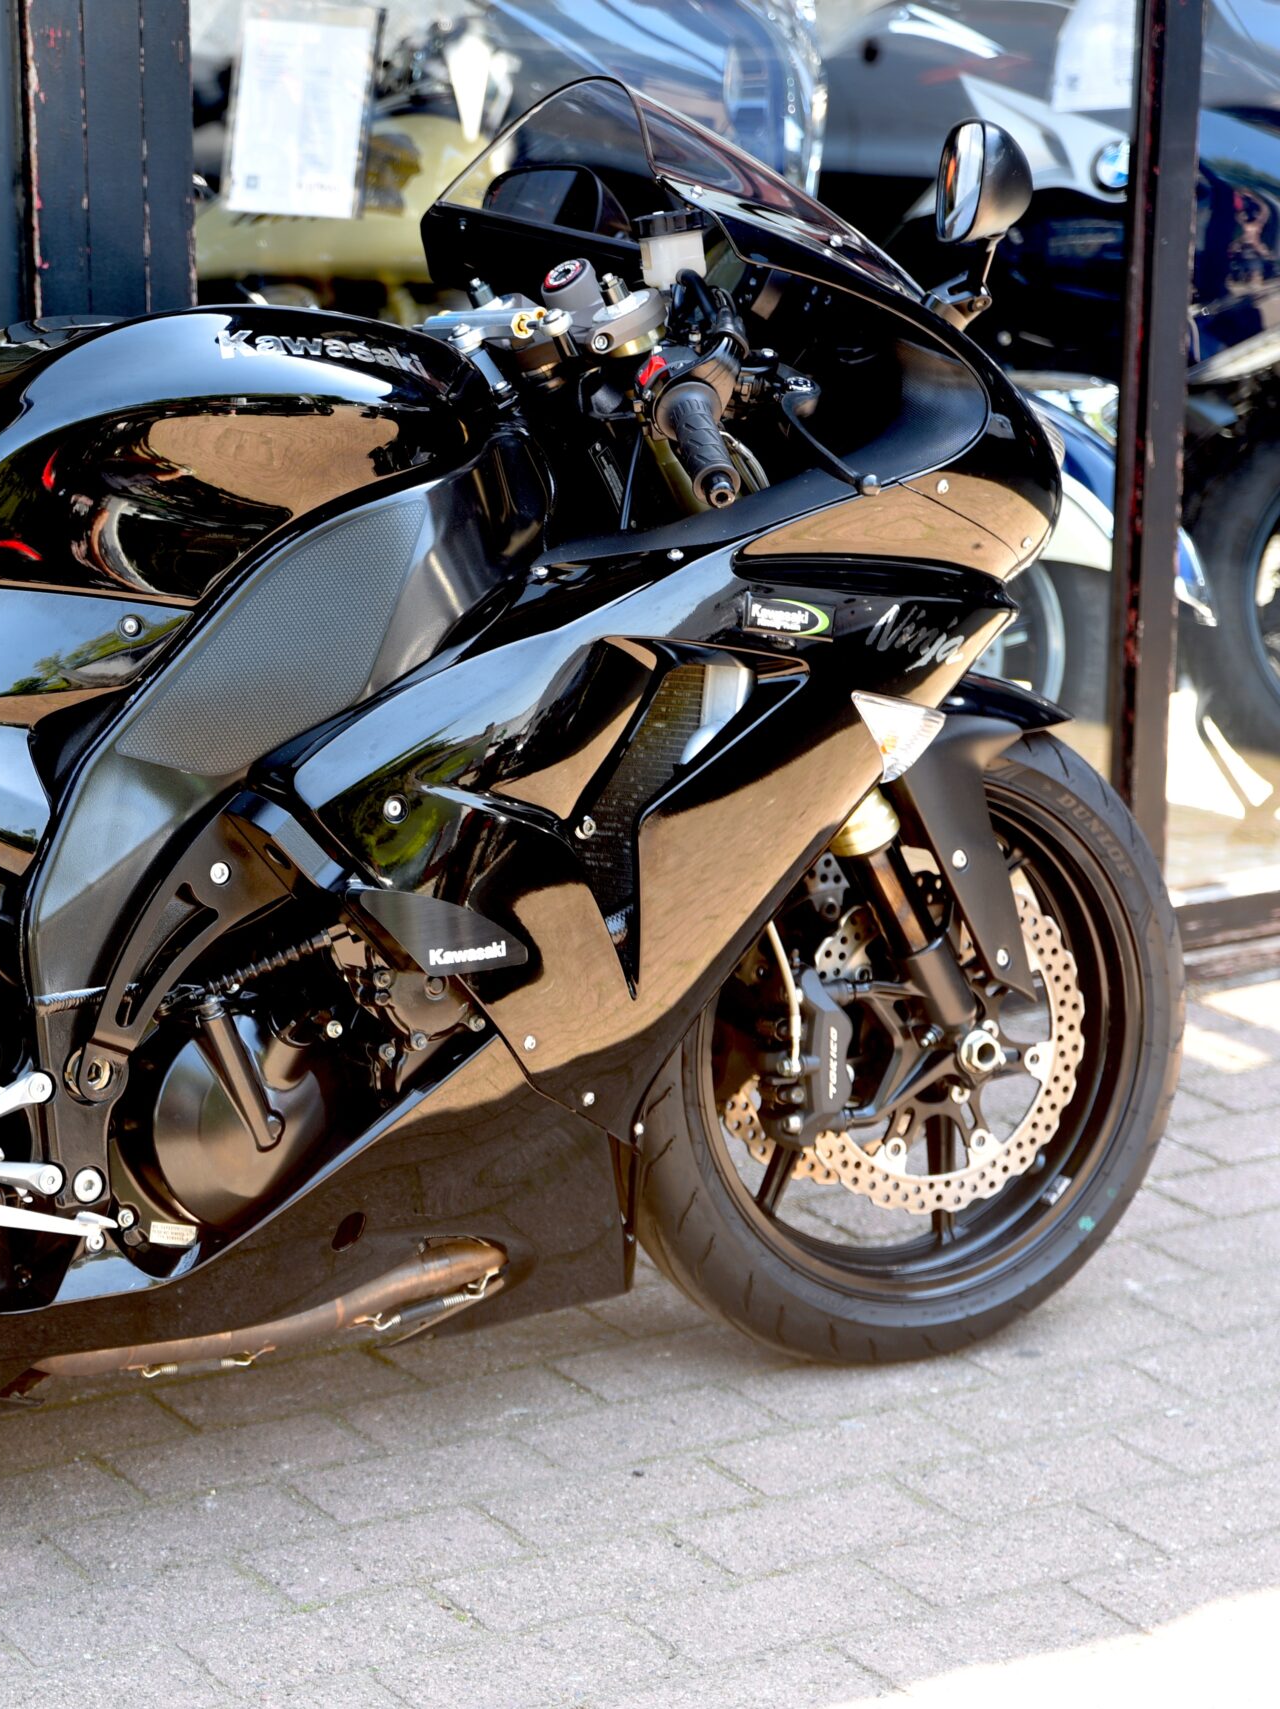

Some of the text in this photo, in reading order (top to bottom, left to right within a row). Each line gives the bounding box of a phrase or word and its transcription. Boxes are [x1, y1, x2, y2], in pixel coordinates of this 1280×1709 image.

[217, 329, 431, 380] Kawasaki
[751, 604, 809, 625] Kawasaki
[865, 603, 965, 672] Ninja
[1056, 793, 1135, 878] DUNLOP
[429, 940, 507, 966] Kawasaki
[828, 1026, 838, 1100] TOKICO
